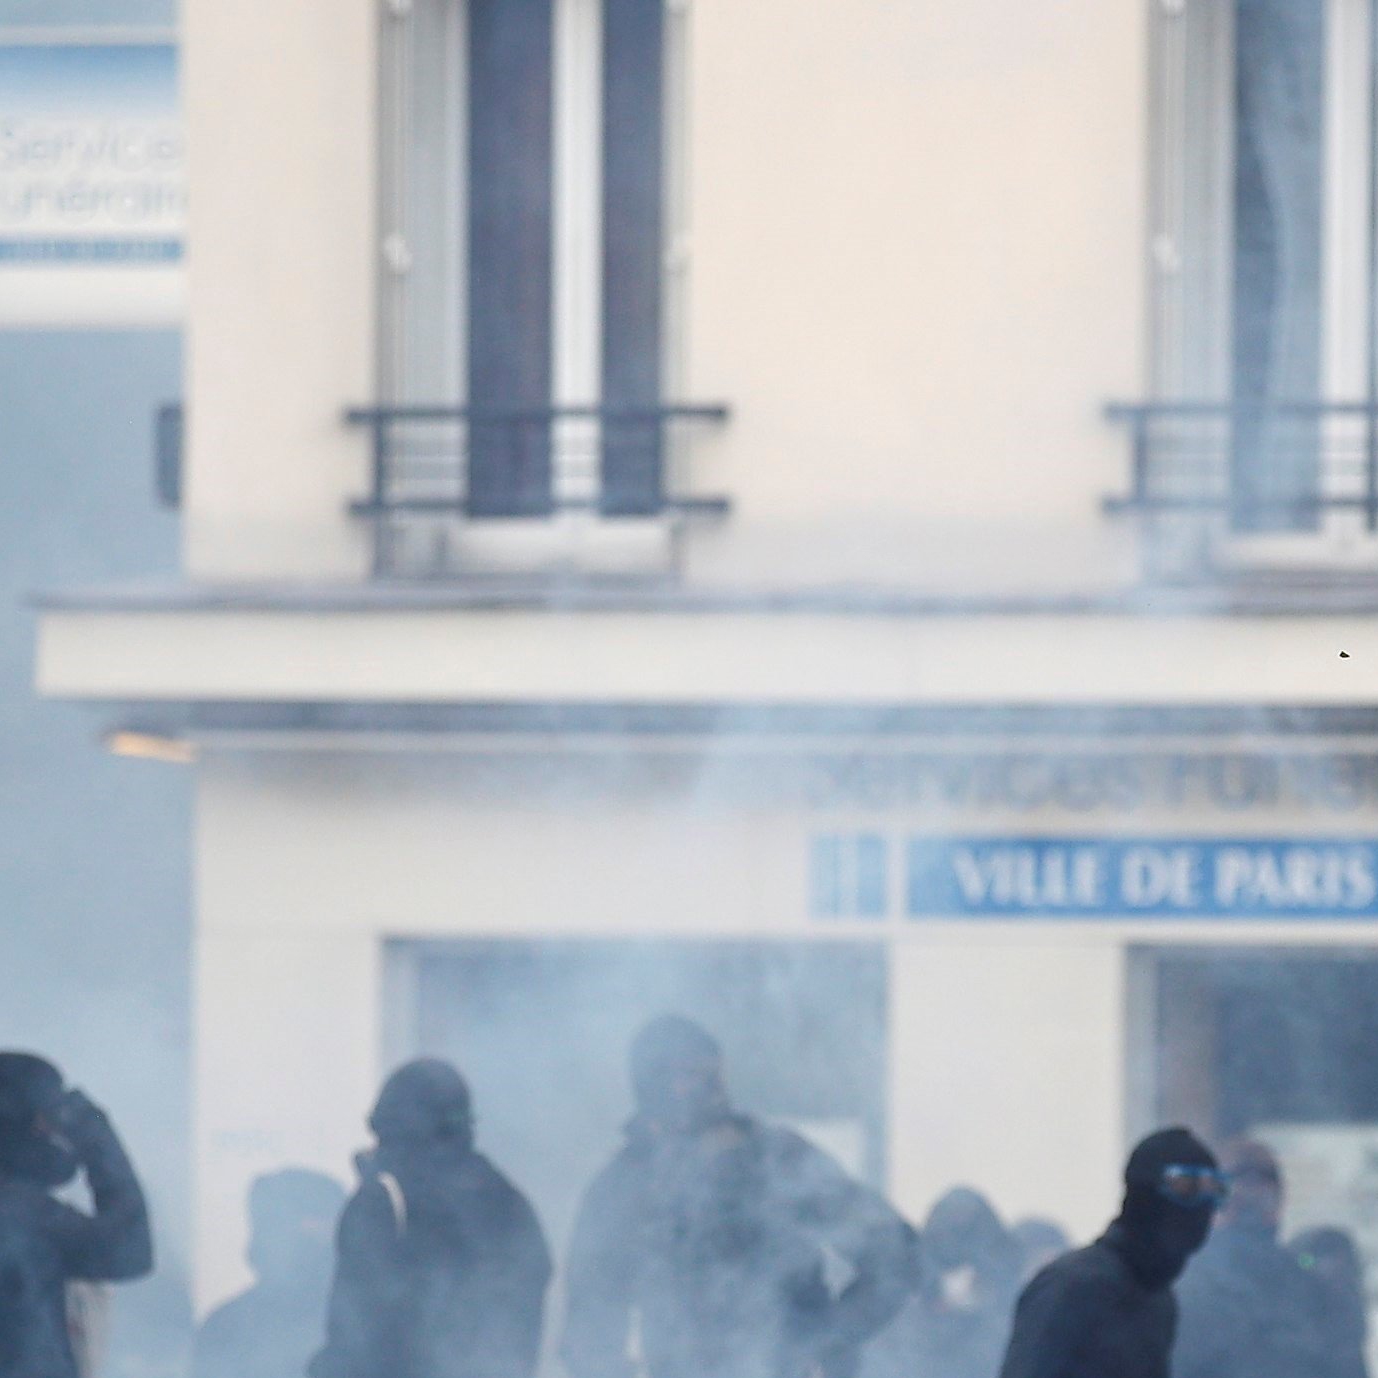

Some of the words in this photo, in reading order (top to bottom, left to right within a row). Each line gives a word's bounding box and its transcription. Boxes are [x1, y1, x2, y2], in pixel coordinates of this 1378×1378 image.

[952, 848, 1104, 907] VILLE
[1123, 848, 1199, 907] DE
[1215, 848, 1377, 908] PARIS
